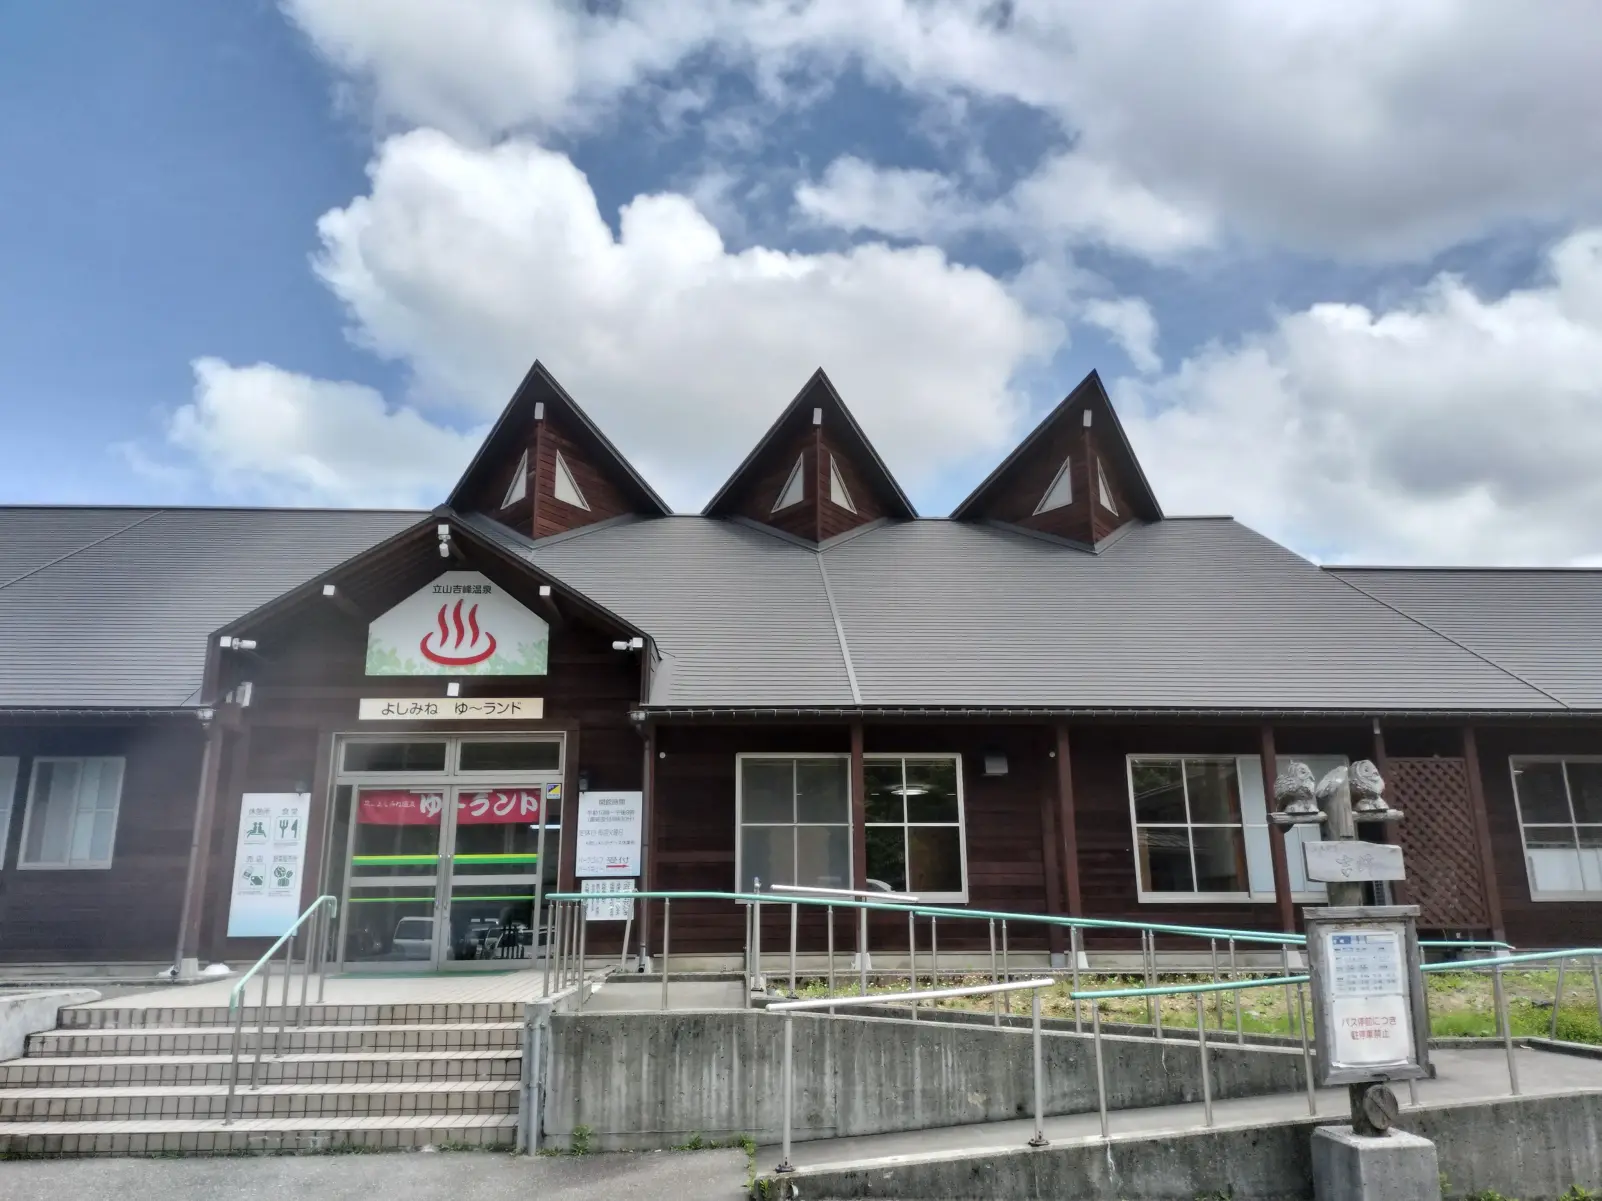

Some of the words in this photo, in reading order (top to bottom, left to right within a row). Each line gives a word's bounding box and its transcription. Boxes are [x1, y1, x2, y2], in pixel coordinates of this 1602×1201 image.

[432, 584, 492, 595] 立山吉峰温泉
[381, 702, 438, 716] よしみね
[420, 791, 541, 818] ゆランド
[1341, 1016, 1397, 1029] バス停前につき
